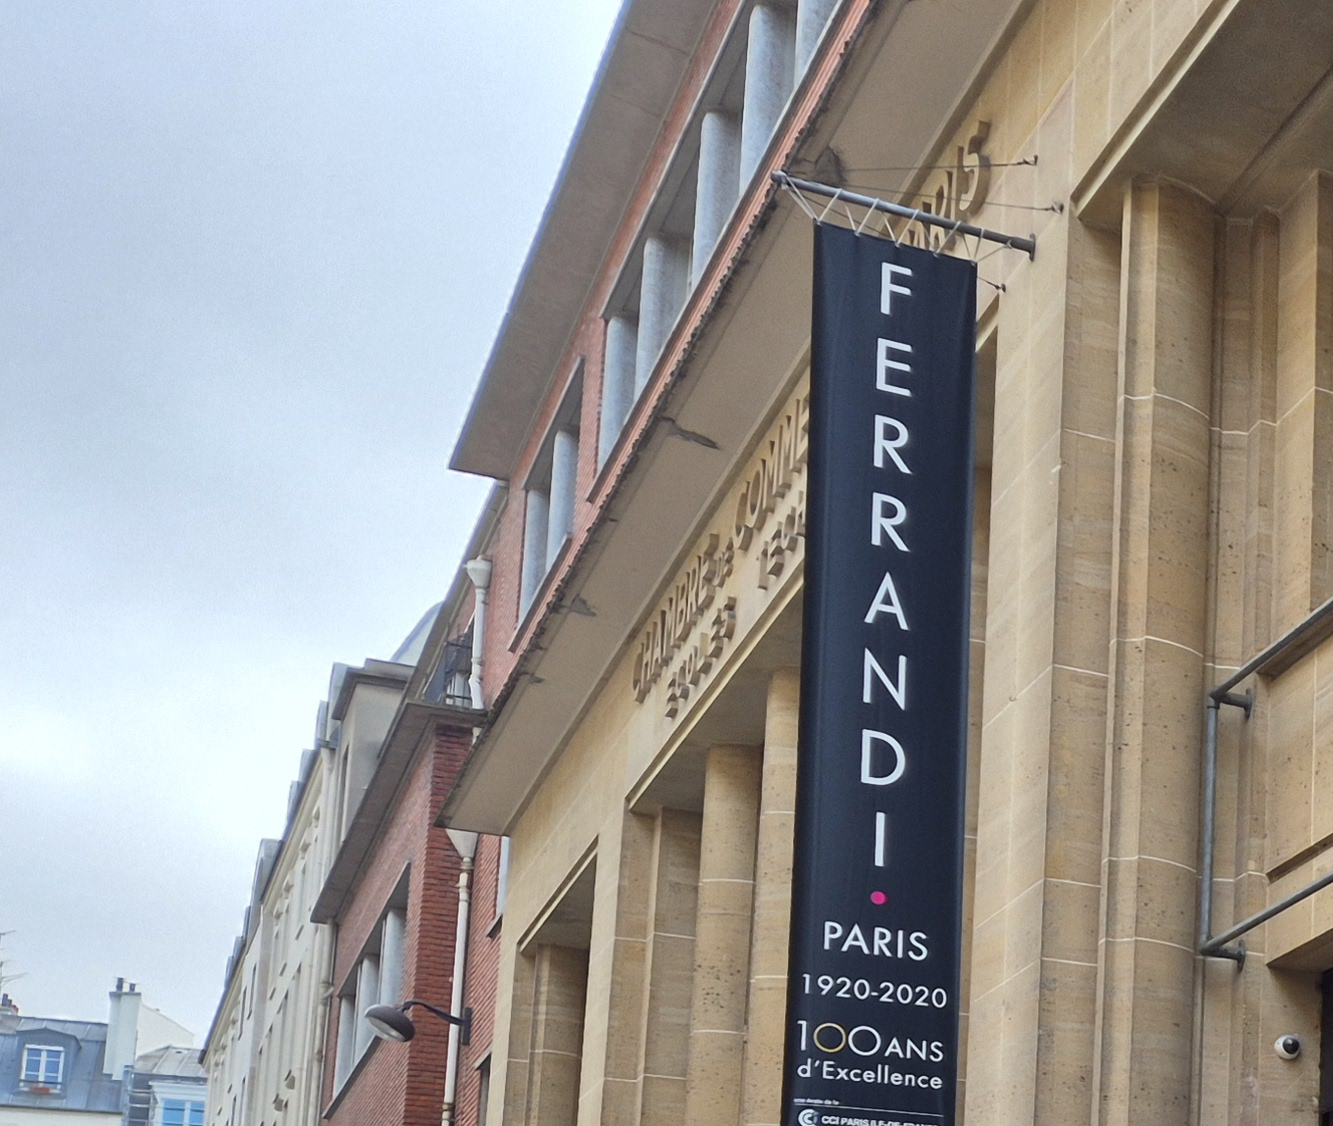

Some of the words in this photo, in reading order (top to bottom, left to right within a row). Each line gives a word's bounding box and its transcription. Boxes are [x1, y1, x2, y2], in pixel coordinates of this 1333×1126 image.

[734, 393, 809, 553] COMME
[860, 261, 914, 868] FERRANDI
[801, 973, 948, 1009] 1920-2020
[823, 920, 930, 962] PARIS
